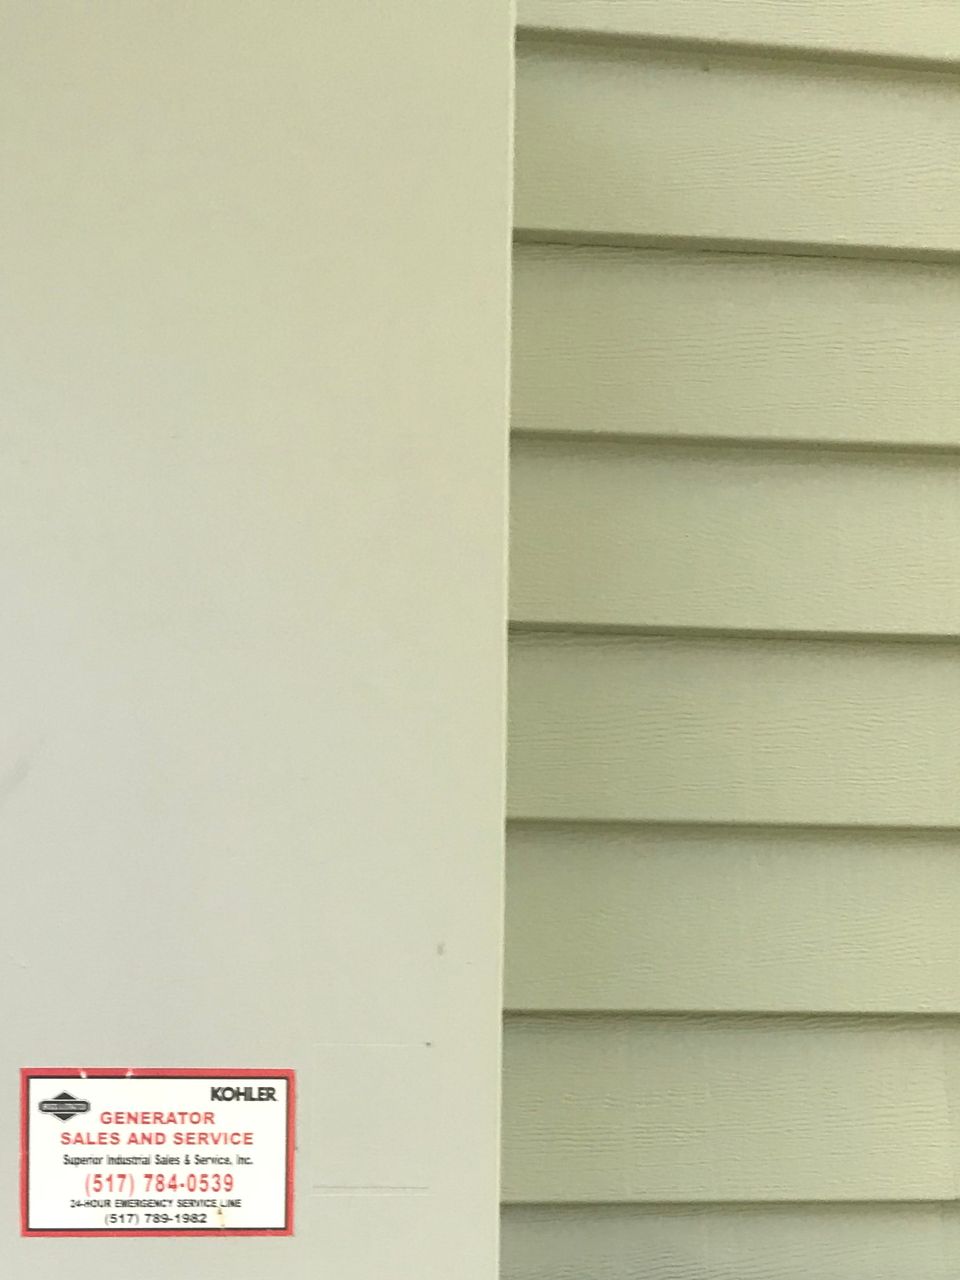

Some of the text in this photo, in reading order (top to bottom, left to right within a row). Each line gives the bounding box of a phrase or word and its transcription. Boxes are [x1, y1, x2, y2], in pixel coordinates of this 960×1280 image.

[210, 1086, 277, 1101] KOHLER
[100, 1111, 216, 1125] GENERATOR
[60, 1132, 254, 1145] SALES AND SERVICE
[63, 1154, 104, 1167] Superior
[106, 1154, 151, 1165] Industrial
[155, 1154, 181, 1165] Sales
[184, 1154, 191, 1165] &
[236, 1154, 254, 1165] Inc.
[85, 1173, 234, 1197] (517) 784-0539
[70, 1199, 242, 1208] 24-HOUR EMERGENCY SERVICE LINE
[104, 1213, 208, 1225] (517) 789-1982
